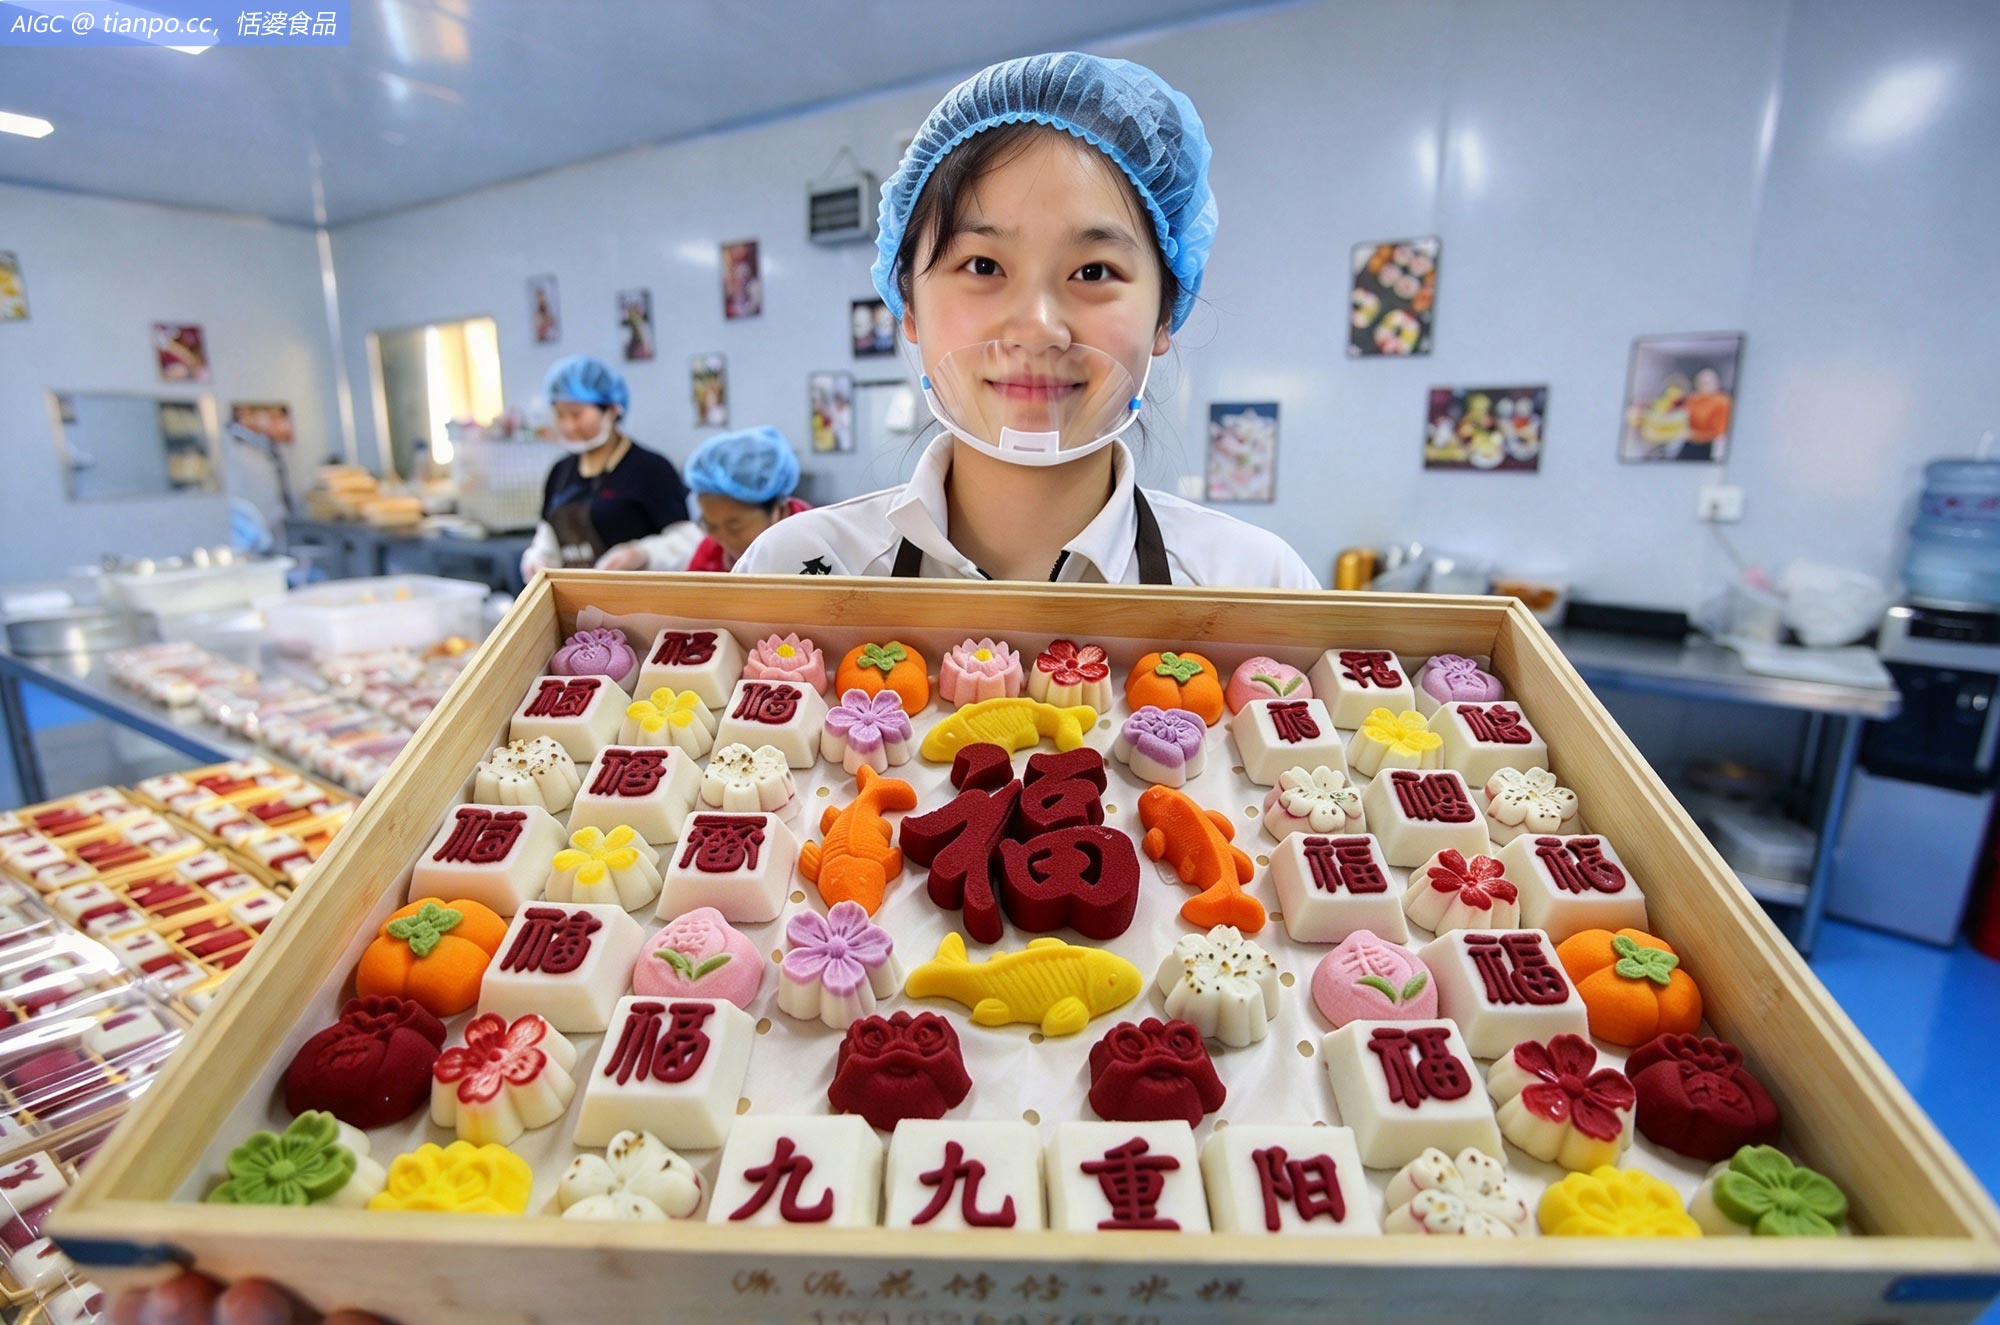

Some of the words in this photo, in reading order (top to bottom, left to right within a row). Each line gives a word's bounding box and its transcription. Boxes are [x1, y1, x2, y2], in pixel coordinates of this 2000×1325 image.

[589, 749, 669, 797] 福
[1391, 771, 1476, 823] 福
[432, 808, 527, 864] 福
[900, 742, 1141, 944] 福
[1303, 836, 1388, 894] 福
[1535, 837, 1626, 894] 福
[498, 907, 603, 975] 福
[1463, 933, 1570, 1006] 福
[603, 1002, 716, 1086] 福
[1367, 1027, 1472, 1109] 福
[728, 1137, 1346, 1233] 九九重阳
